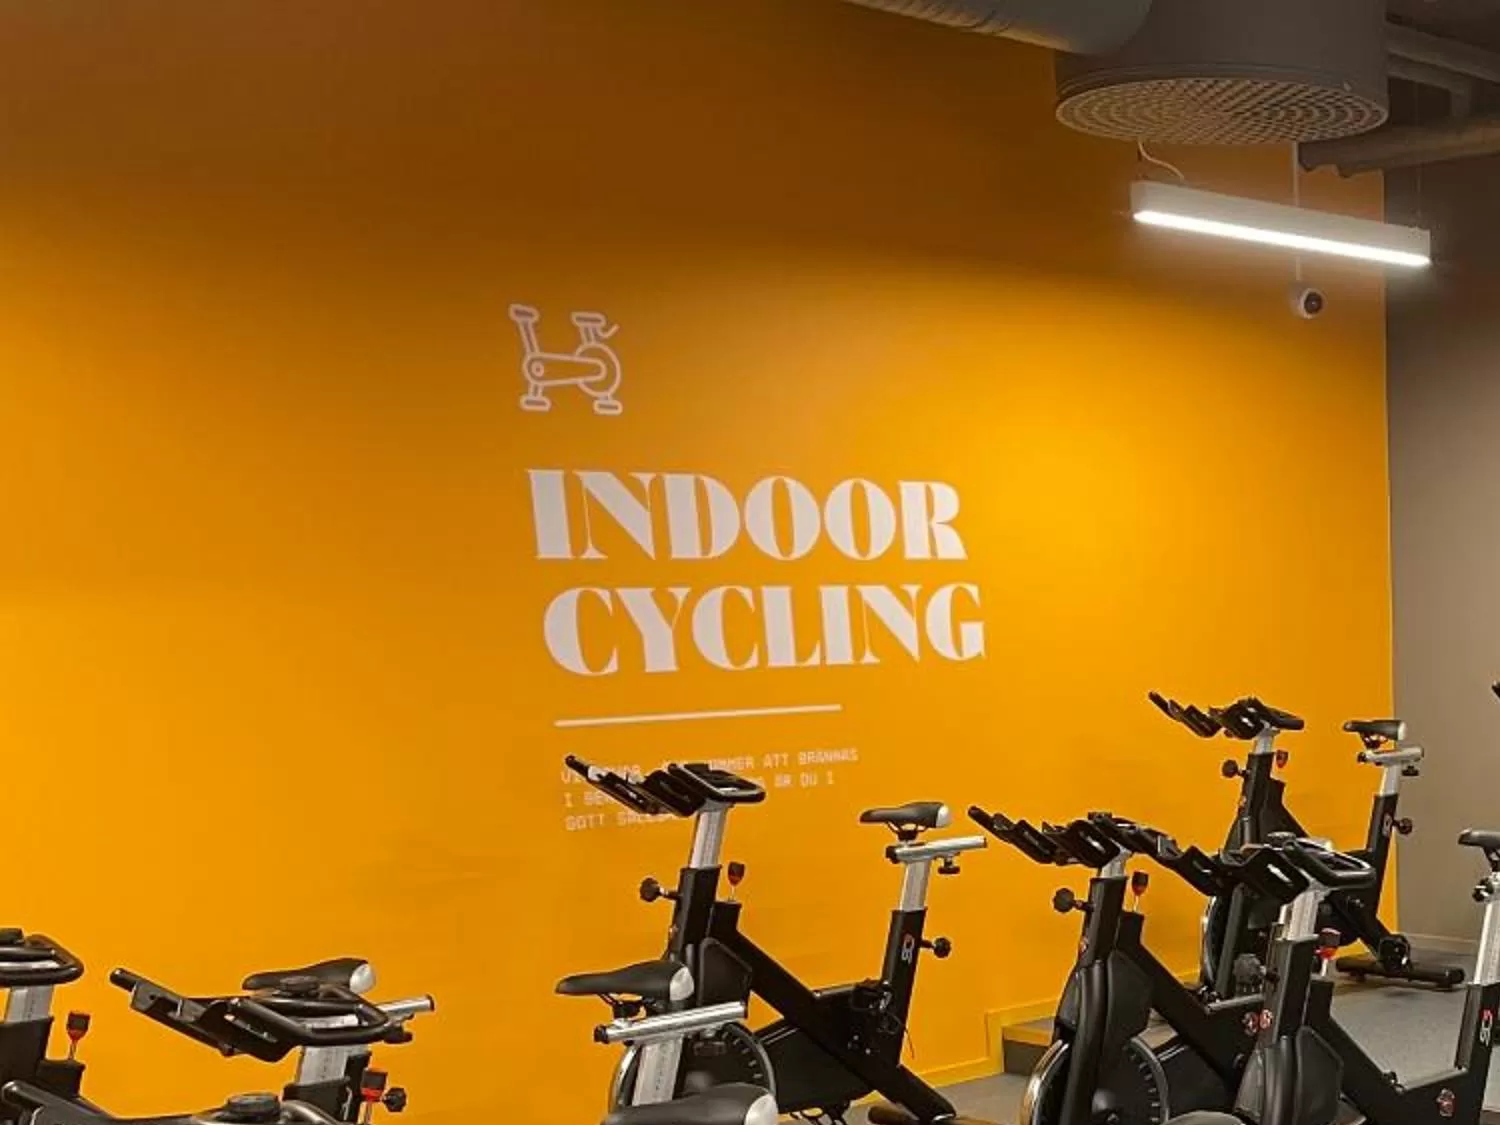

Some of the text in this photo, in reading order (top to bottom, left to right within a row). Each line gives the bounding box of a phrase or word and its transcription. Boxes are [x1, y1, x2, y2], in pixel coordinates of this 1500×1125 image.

[527, 468, 969, 561] INDOOR
[543, 582, 986, 677] CYCLING
[763, 751, 789, 769] ATT
[564, 813, 605, 832] GOTT
